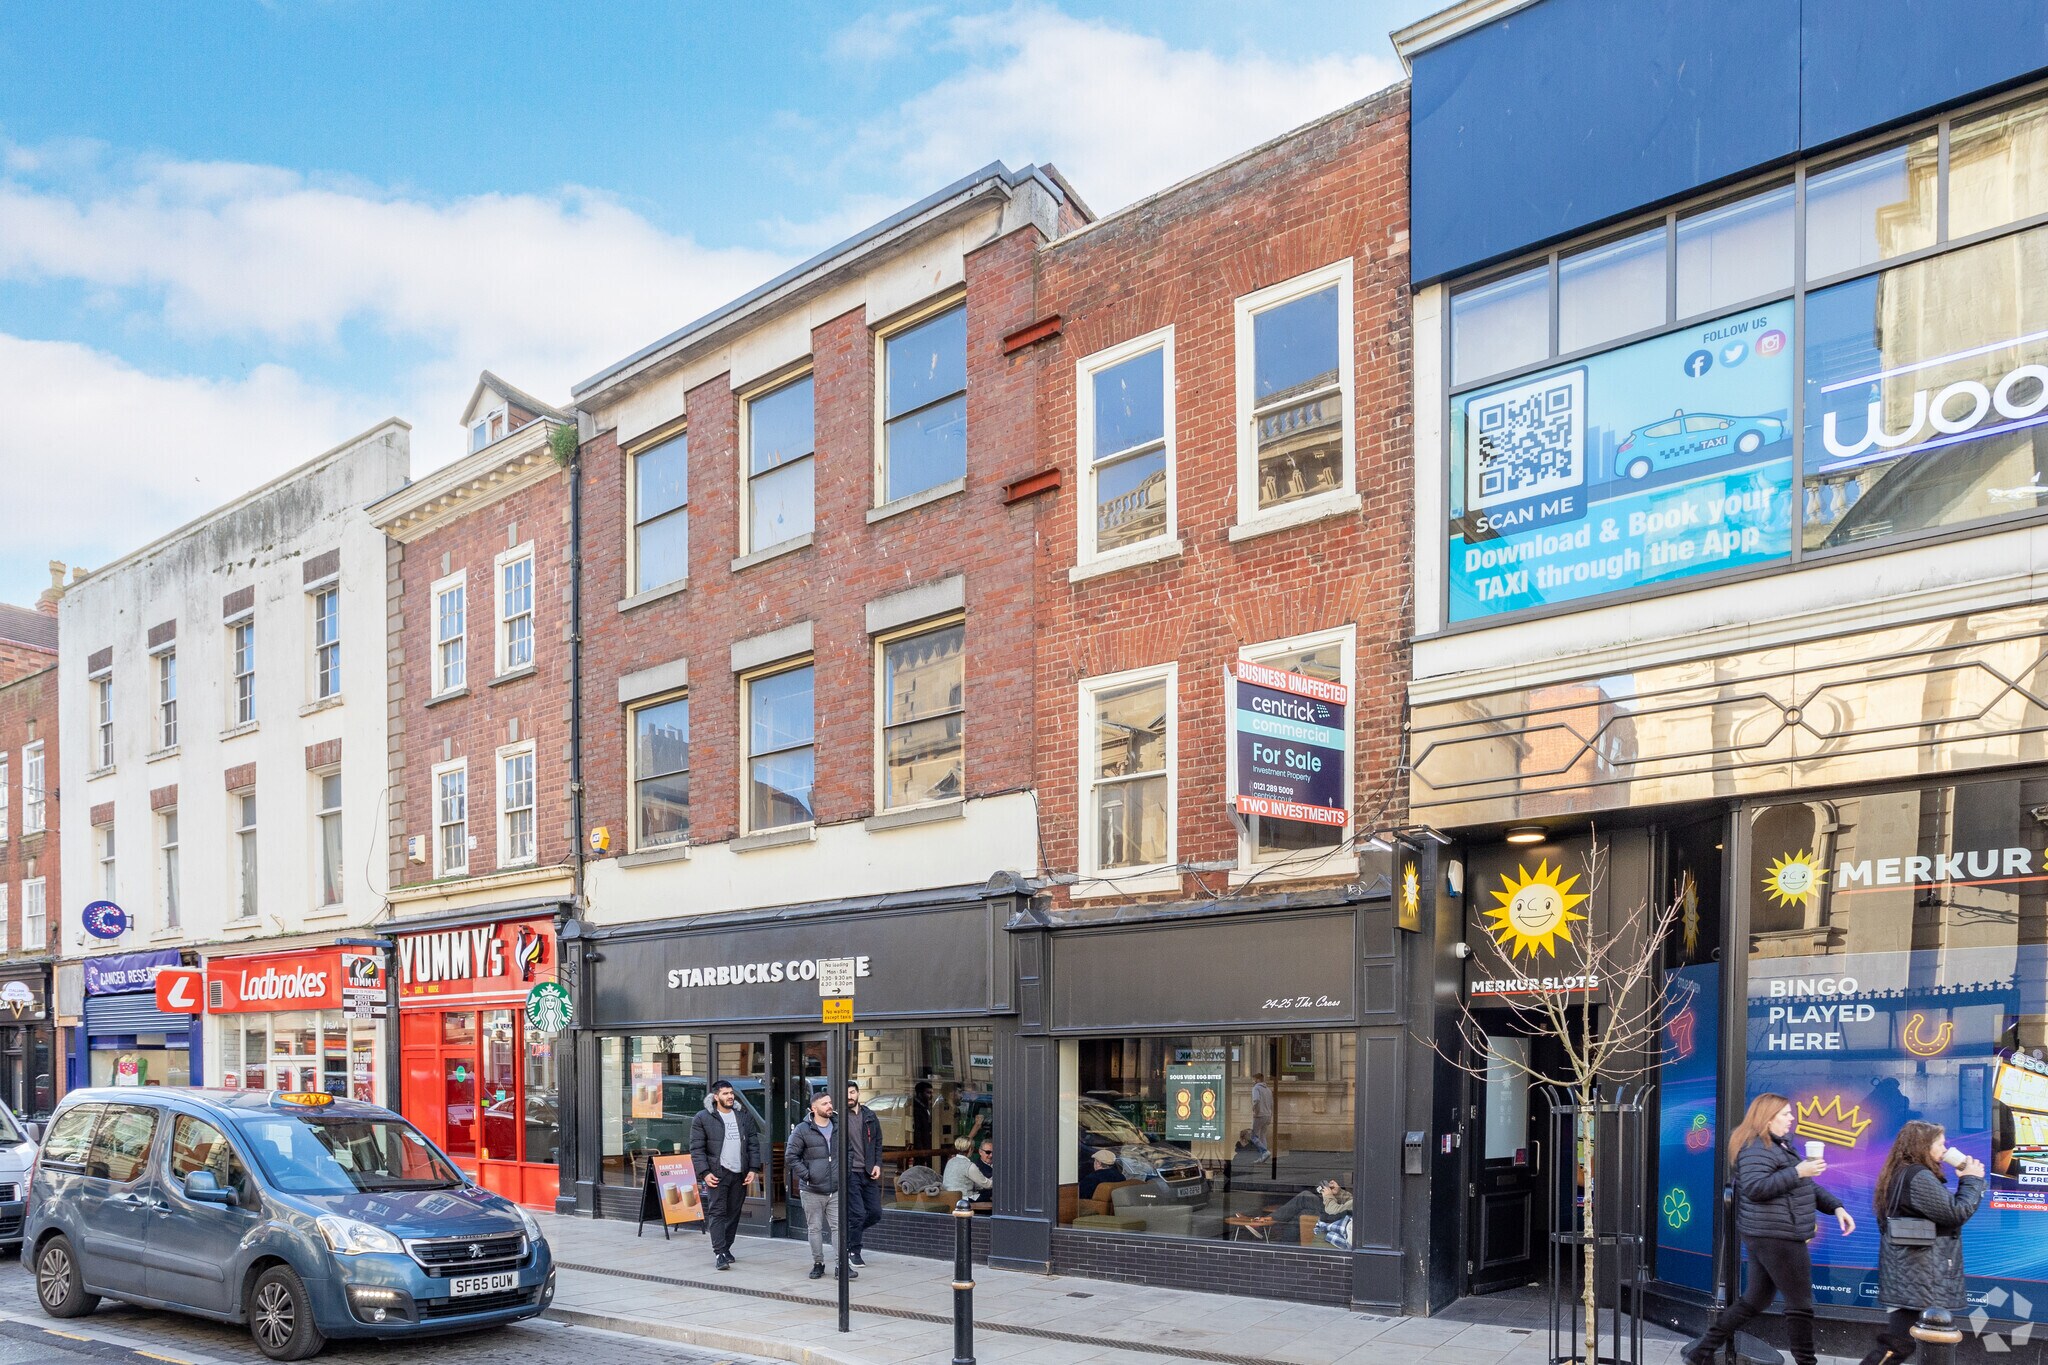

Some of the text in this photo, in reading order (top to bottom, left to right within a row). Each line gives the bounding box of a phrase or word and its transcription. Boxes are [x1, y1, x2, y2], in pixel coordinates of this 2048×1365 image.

[1702, 316, 1768, 345] FOLLOW US
[1701, 435, 1728, 451] TAXI
[1475, 496, 1574, 534] SCAN ME
[1465, 486, 1775, 573] Download & Book your
[1475, 525, 1761, 602] TAXI through the App
[1238, 662, 1347, 703] BUSINESS UNAFFECTED
[1252, 696, 1316, 723] centrick
[1252, 717, 1330, 744] commercial
[1253, 742, 1322, 773] For Sale
[1252, 765, 1312, 783] Investment Property
[1253, 782, 1266, 791] 0121
[1266, 784, 1278, 793] 289
[1278, 786, 1294, 796] 5009
[1240, 798, 1345, 825] TWO INVESTMENTS
[1838, 847, 2034, 888] MERKUR
[100, 970, 126, 986] CANCER
[240, 965, 327, 1001] Ladbrokes
[668, 956, 870, 989] STARBUCKS COE
[1471, 975, 1599, 993] MERKUR SLOTS
[1769, 977, 1859, 998] BINGO
[1262, 994, 1341, 1009] 24-25 The Cross
[1769, 1004, 1876, 1024] PLAYED
[1768, 1032, 1841, 1051] HERE
[295, 1094, 327, 1105] TAXI
[456, 1274, 513, 1293] SF65 GUW
[1811, 1283, 1852, 1294] Aware.org
